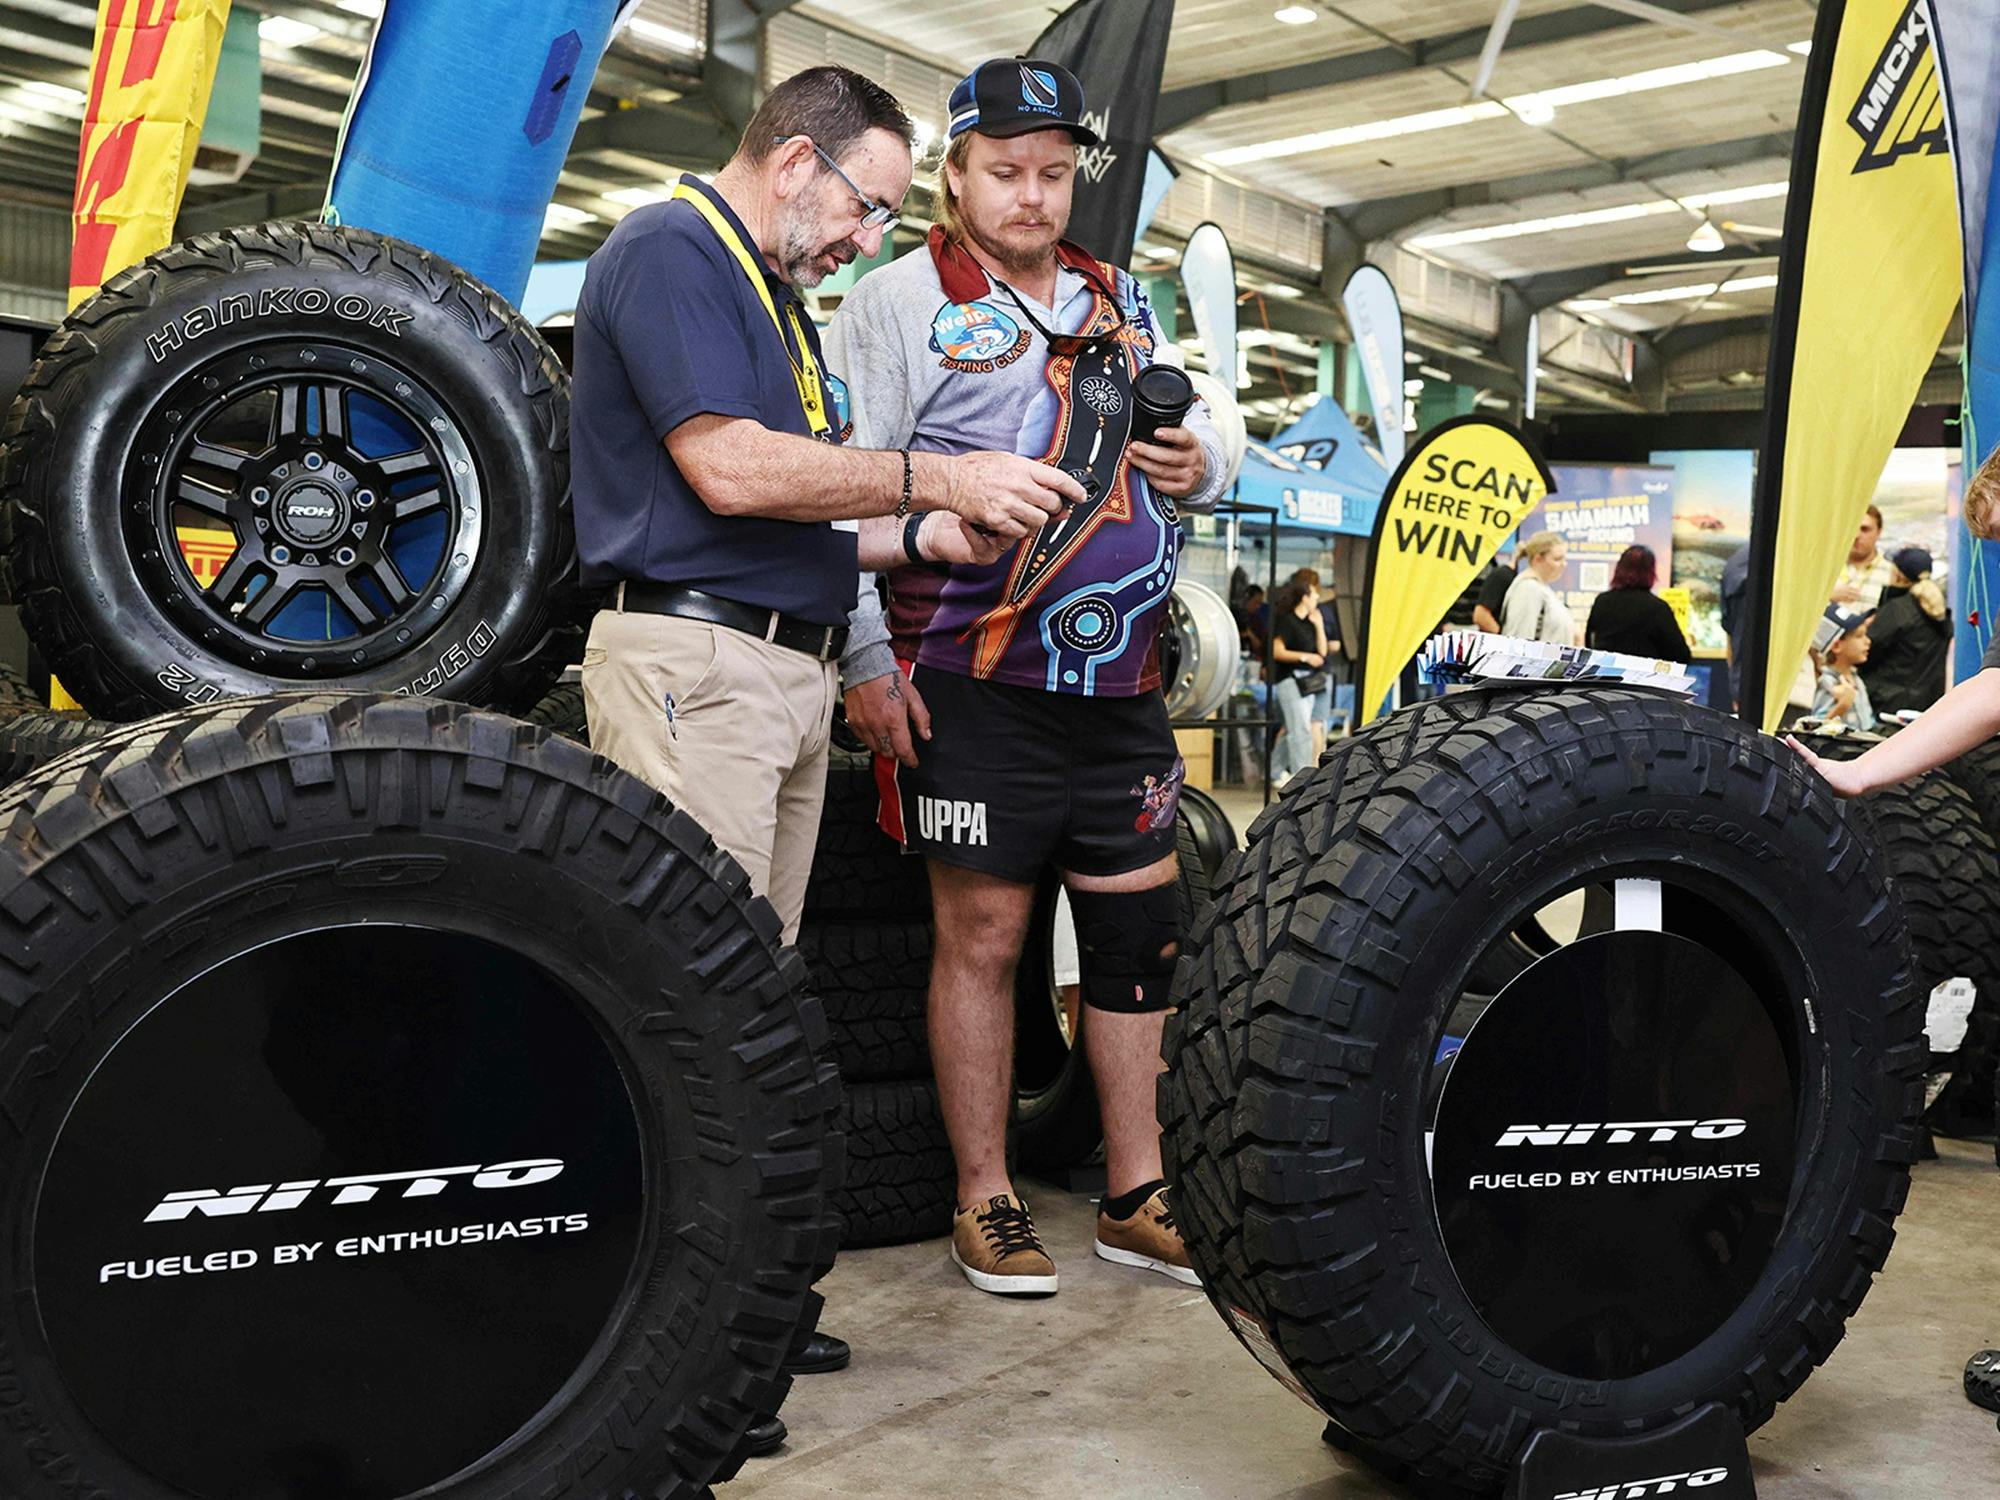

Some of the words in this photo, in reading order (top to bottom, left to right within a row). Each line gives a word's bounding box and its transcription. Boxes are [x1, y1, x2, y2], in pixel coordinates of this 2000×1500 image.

[1857, 0, 1928, 132] MICK
[1017, 104, 1031, 113] NO
[1073, 146, 1117, 184] AOS
[939, 358, 994, 373] FISHING
[996, 329, 1033, 368] CLASSIC
[1423, 453, 1533, 505] SCAN
[287, 505, 335, 518] ROH
[1403, 489, 1471, 520] HERE
[1480, 504, 1512, 529] TO
[1544, 504, 1650, 533] SAVANNAH
[1395, 518, 1483, 567] WIN
[391, 620, 498, 697] Dyn
[155, 663, 222, 705] T2
[917, 795, 988, 846] UPPA
[1495, 1118, 1747, 1147] NITTO
[143, 1158, 565, 1223] NITTO
[1468, 1172, 1562, 1190] FUELED
[1570, 1170, 1600, 1186] BY
[1607, 1162, 1761, 1184] ENTHUSIASTS
[99, 1249, 258, 1283] FUELED
[272, 1241, 323, 1265] BY
[334, 1212, 589, 1257] ENTHUSIASTS
